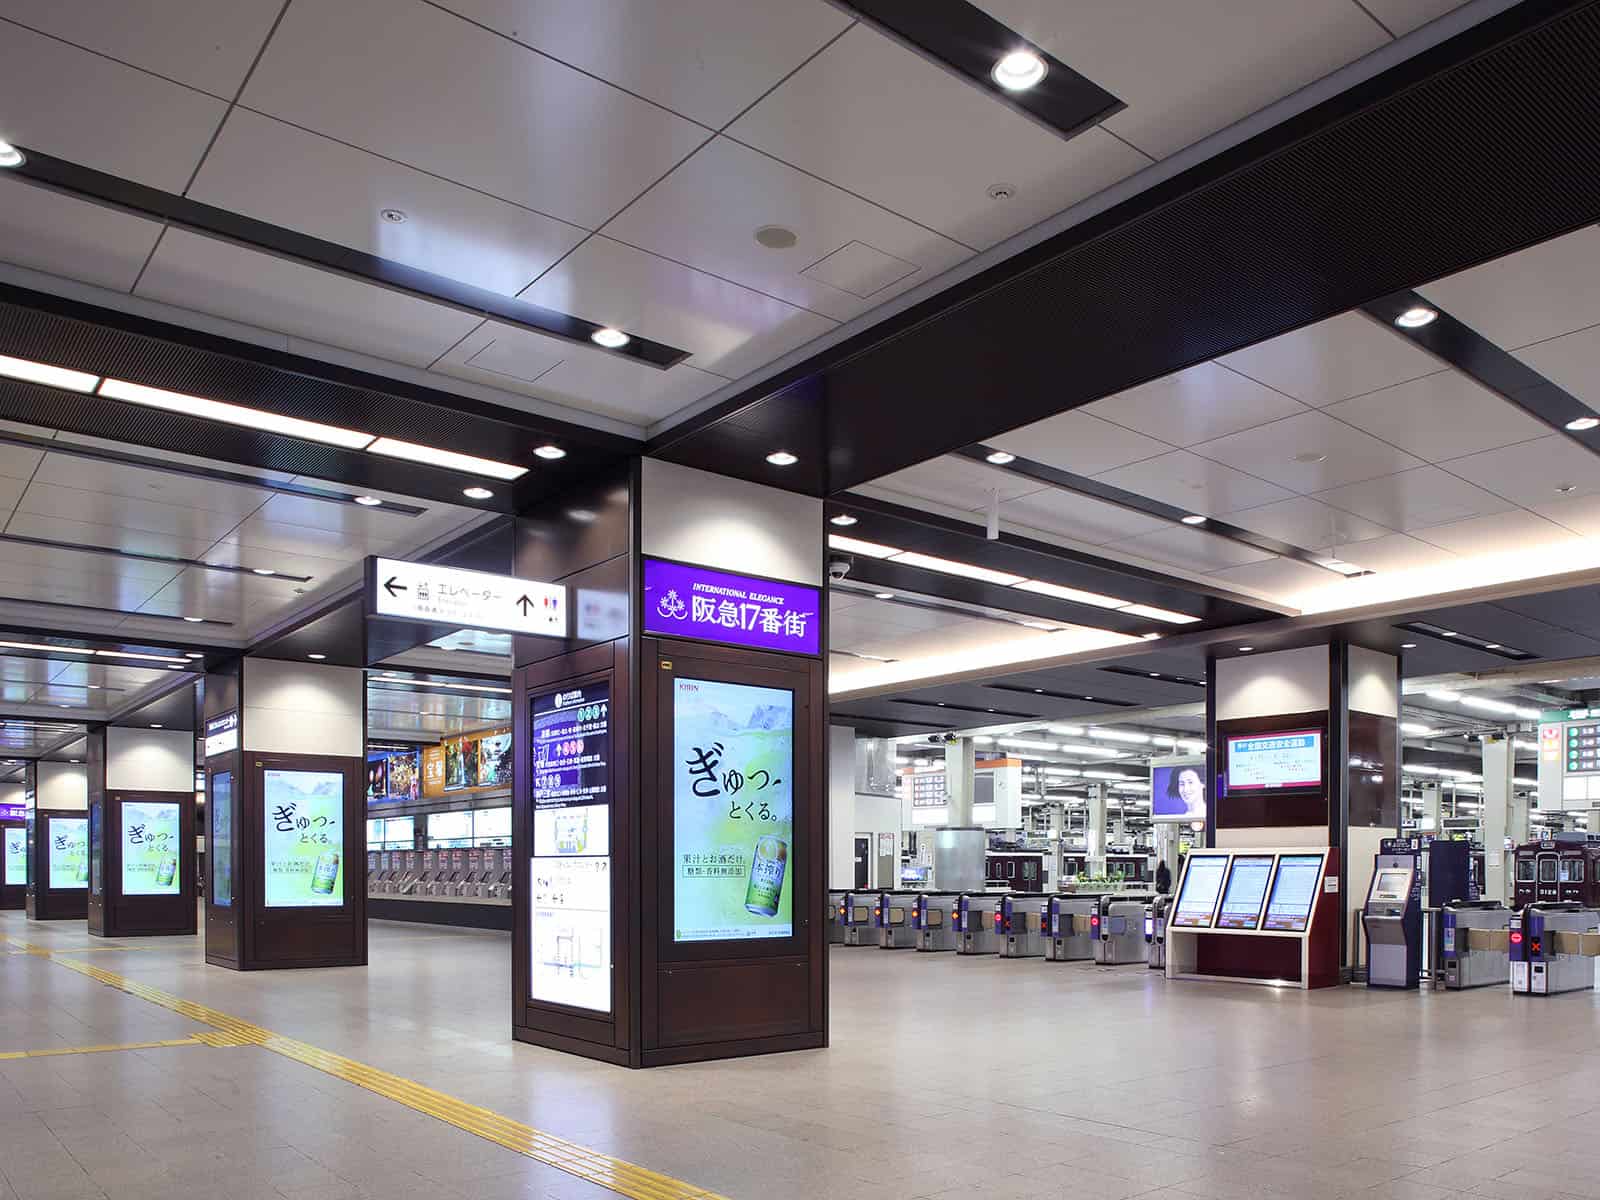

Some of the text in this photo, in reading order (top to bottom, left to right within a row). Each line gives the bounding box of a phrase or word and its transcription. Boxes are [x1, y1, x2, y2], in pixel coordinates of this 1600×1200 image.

[437, 583, 503, 601] エレベーター
[692, 582, 785, 605] INTERNATIONAL ELEGANCE
[691, 594, 807, 638] 阪急17番街
[729, 800, 777, 822] とくる。
